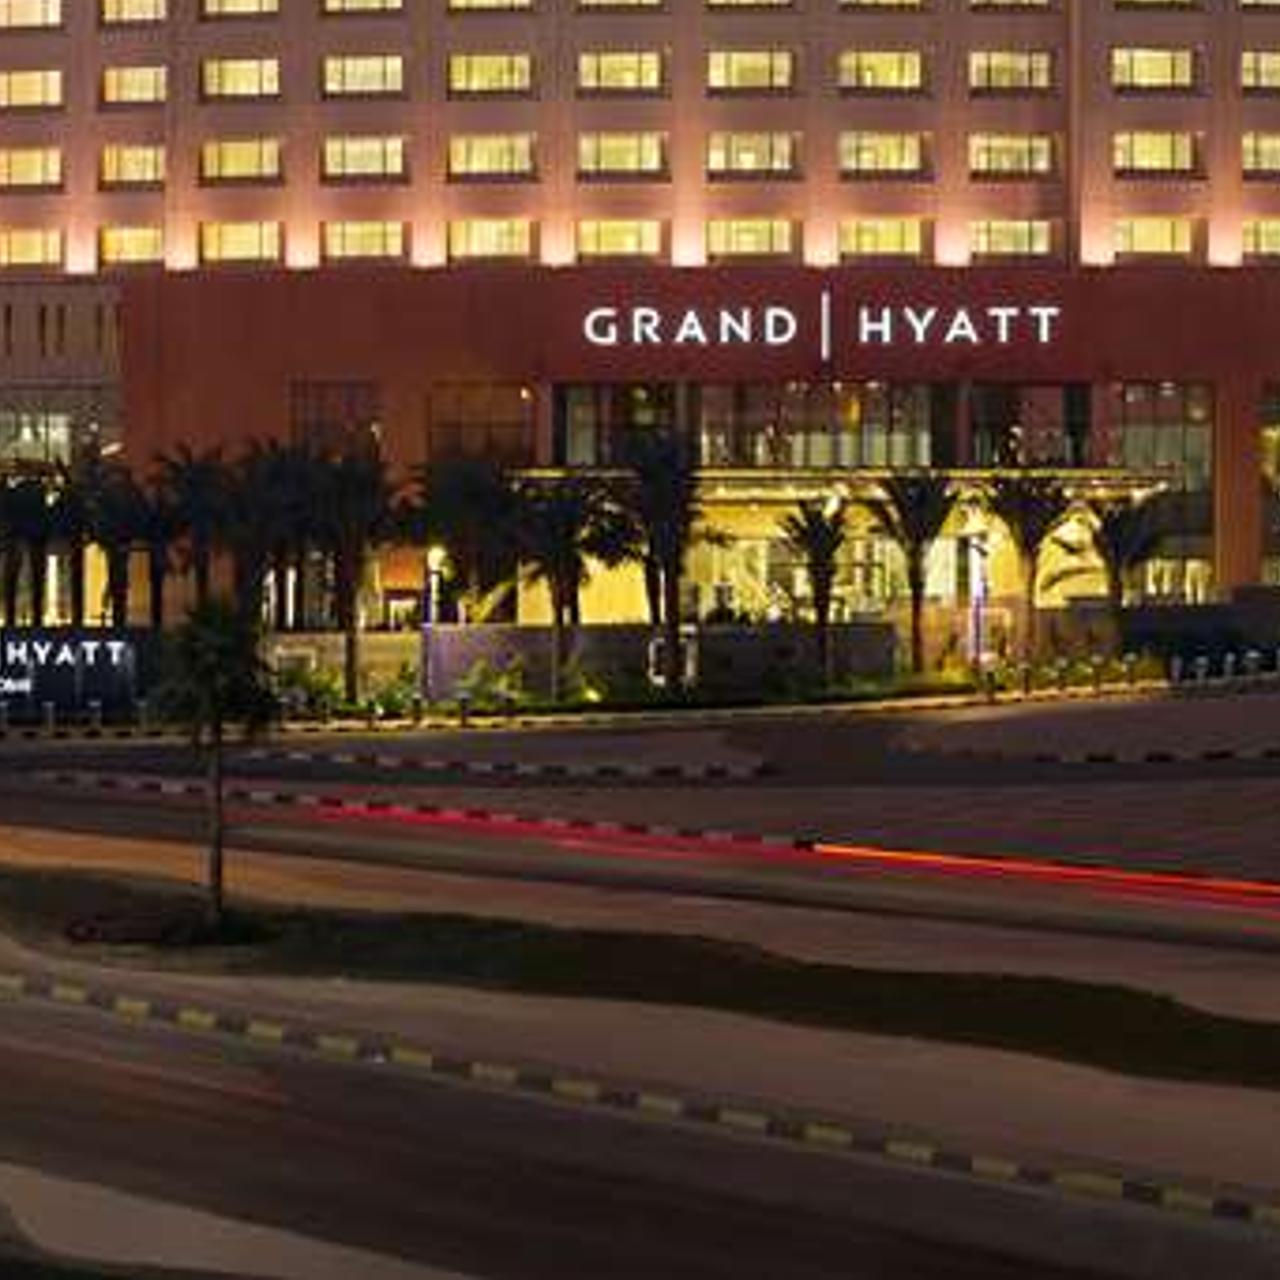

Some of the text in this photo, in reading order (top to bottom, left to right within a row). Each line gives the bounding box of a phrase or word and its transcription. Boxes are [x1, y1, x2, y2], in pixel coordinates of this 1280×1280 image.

[583, 306, 1060, 344] GRAND HYATT
[6, 640, 125, 665] HYATT
